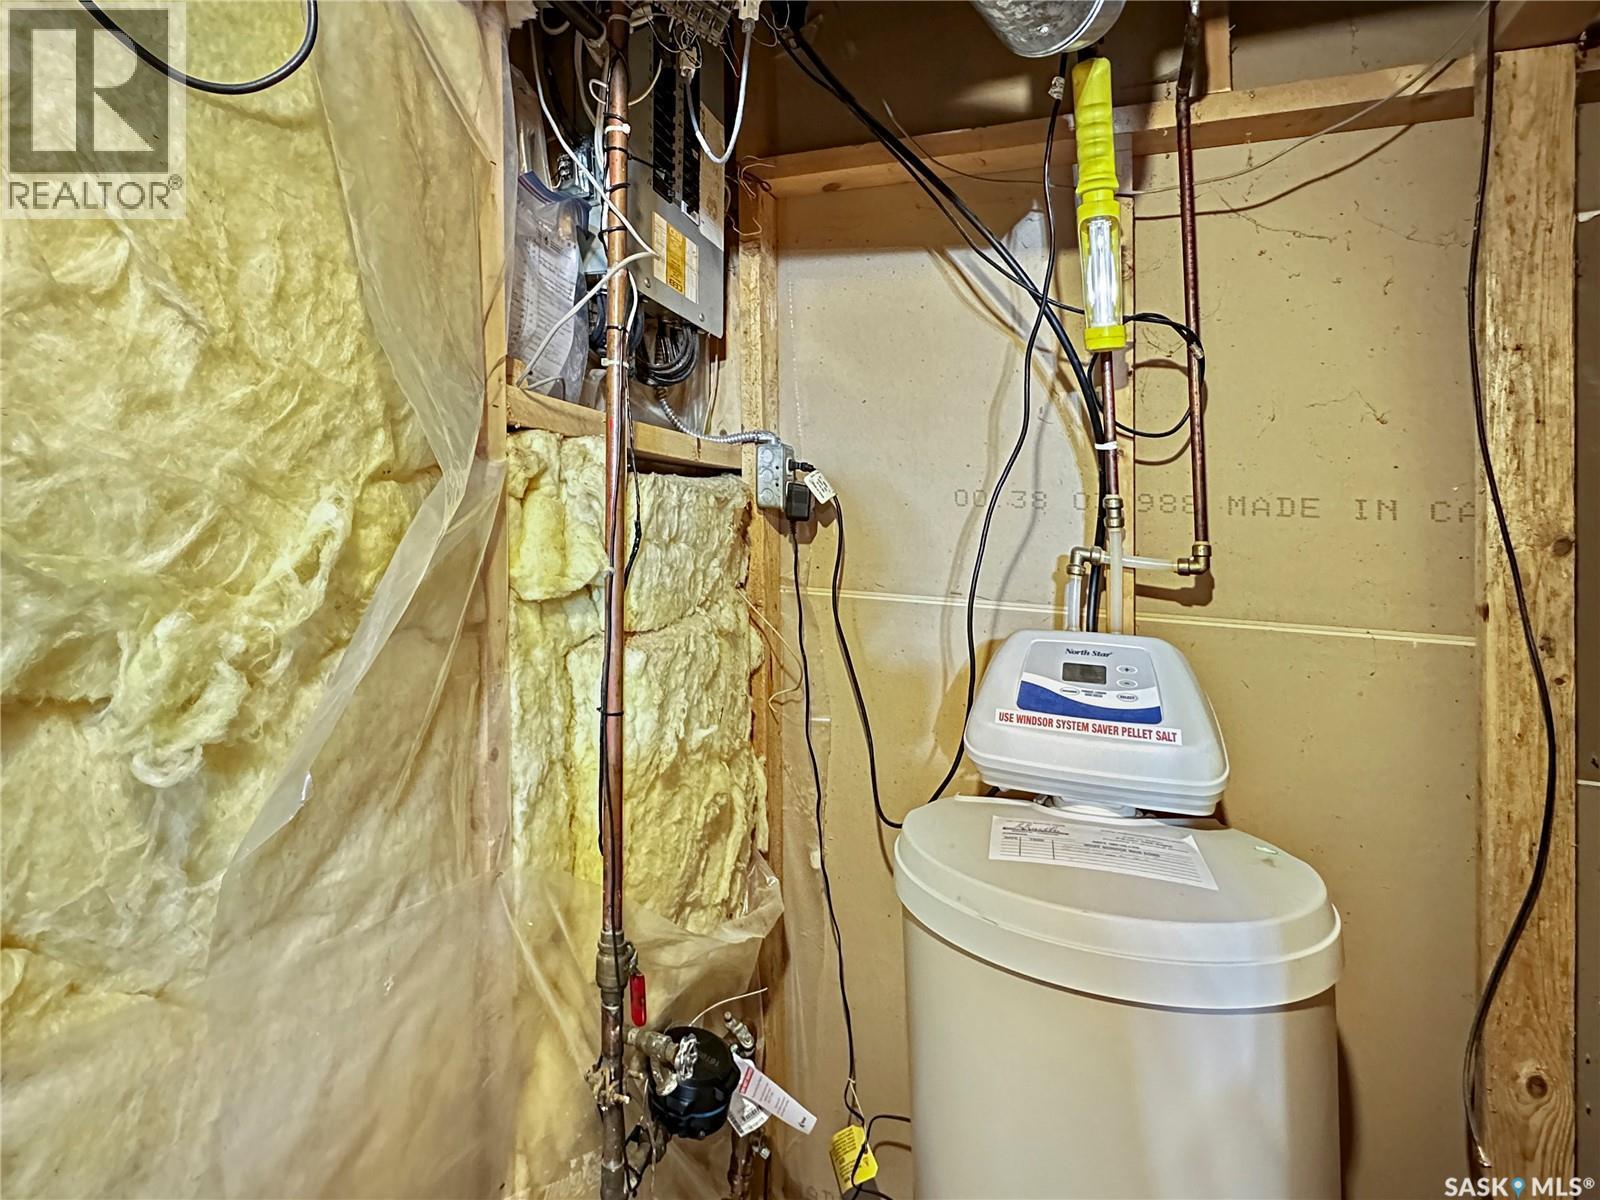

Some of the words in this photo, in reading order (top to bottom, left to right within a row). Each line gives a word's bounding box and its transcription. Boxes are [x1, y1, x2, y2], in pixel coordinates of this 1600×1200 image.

[1227, 495, 1321, 518] MADE
[1355, 498, 1398, 521] IN
[1065, 648, 1090, 657] North
[998, 711, 1014, 723] USE
[1016, 714, 1054, 728] WINDSOR
[1055, 718, 1090, 733] SYSTEM
[1091, 723, 1119, 736] SAVER
[1121, 726, 1153, 740] PELLET
[1155, 730, 1178, 743] SALT
